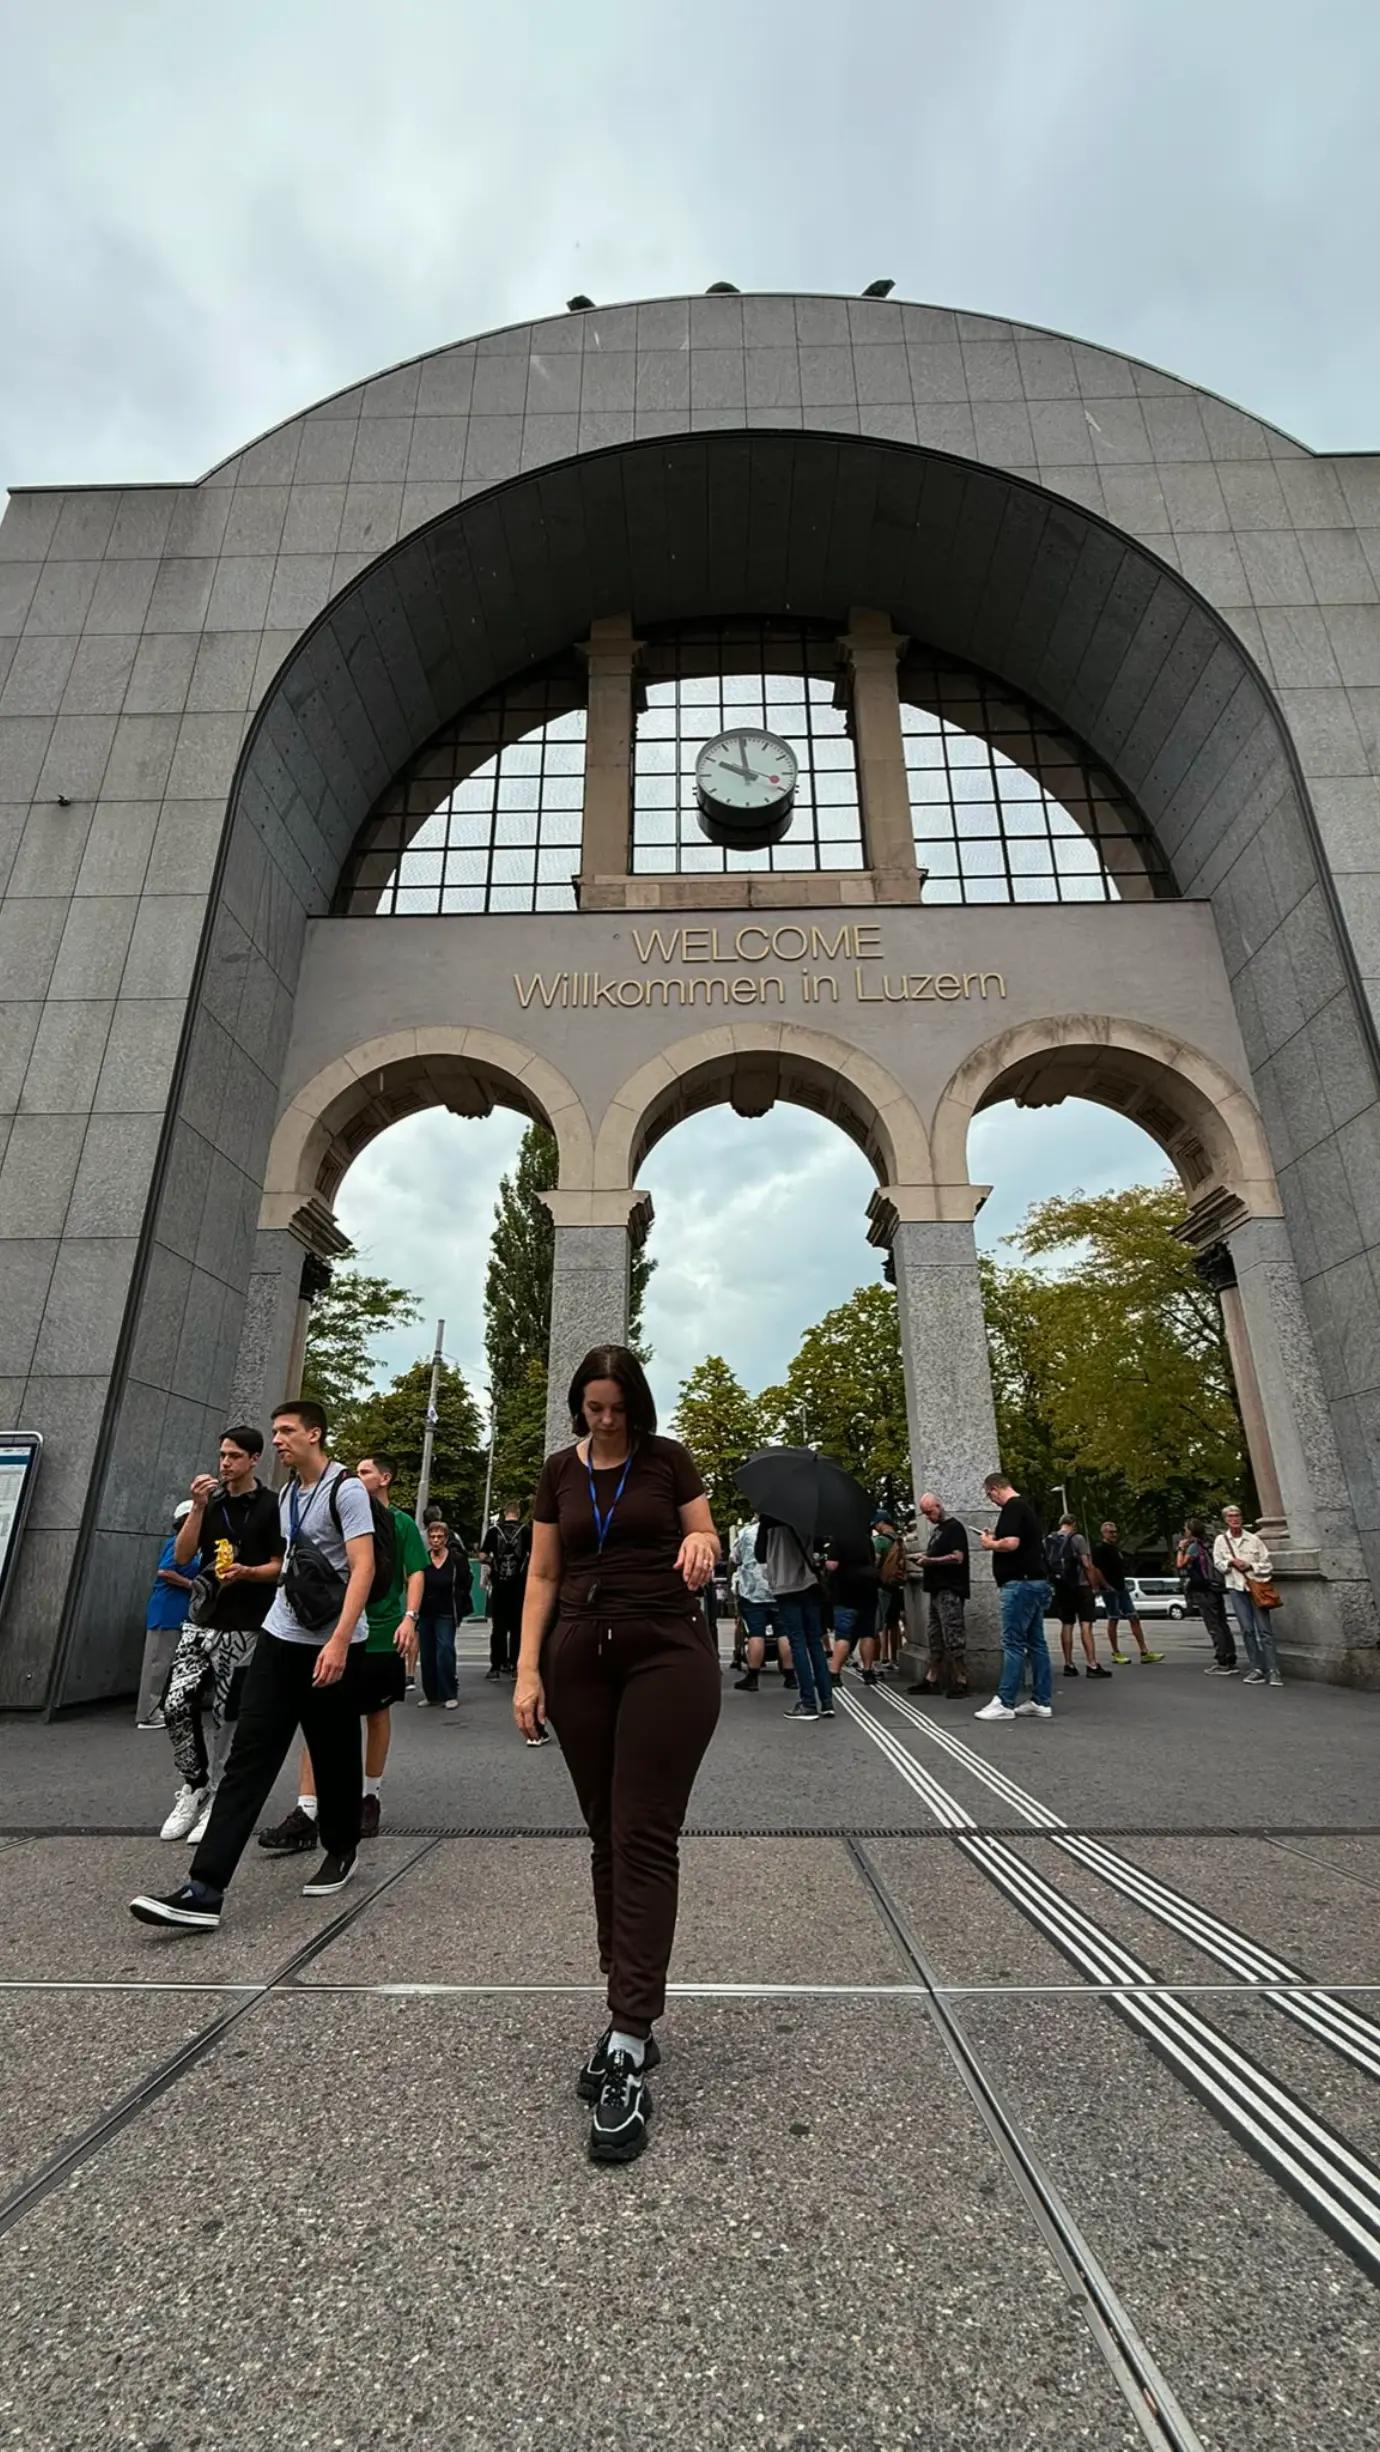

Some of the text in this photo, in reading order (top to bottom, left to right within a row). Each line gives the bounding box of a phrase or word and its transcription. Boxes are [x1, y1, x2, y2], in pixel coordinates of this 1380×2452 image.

[631, 924, 884, 964] WELCOME
[513, 966, 1007, 1008] Willkommen in Luzern
